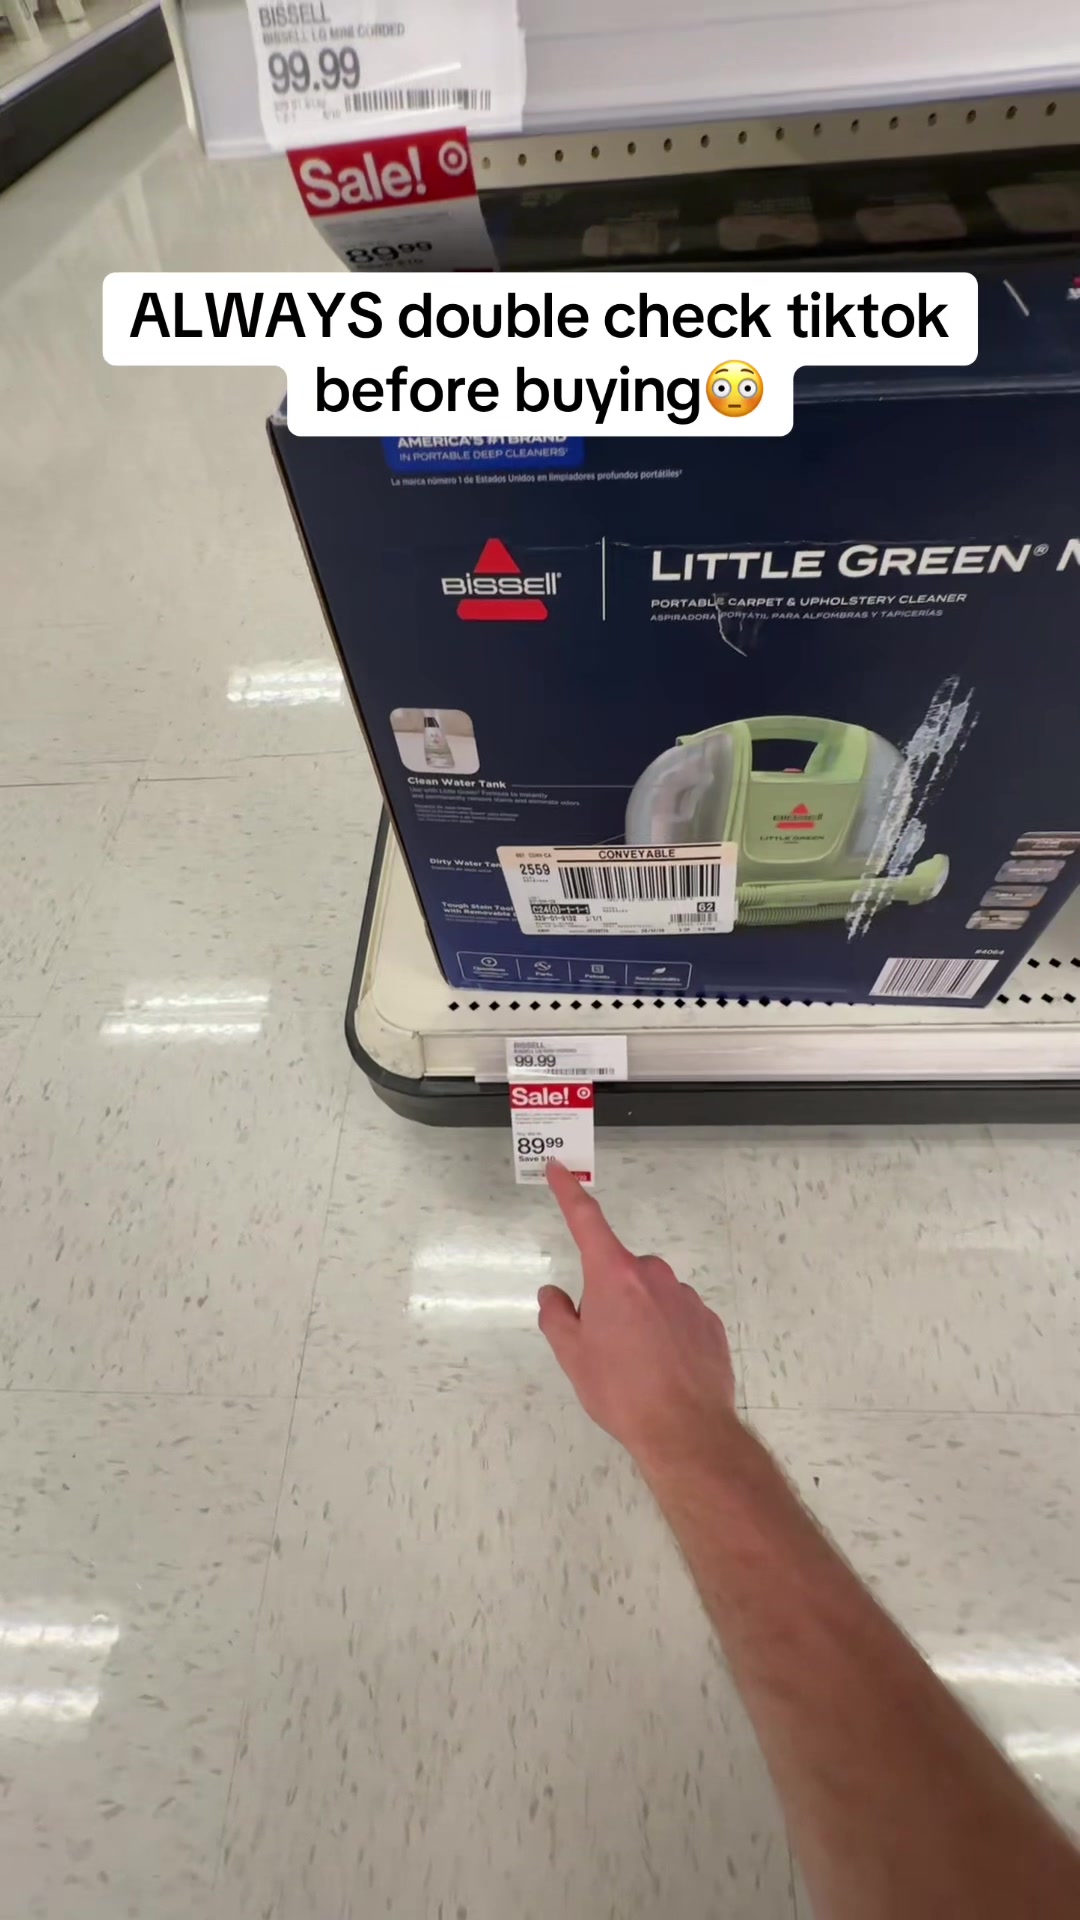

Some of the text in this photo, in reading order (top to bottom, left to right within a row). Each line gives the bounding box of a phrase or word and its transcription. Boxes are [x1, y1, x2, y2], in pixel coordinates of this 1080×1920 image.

[259, 1, 331, 28] BISSELL
[268, 47, 361, 95] 99.99
[300, 146, 427, 208] Sale!
[400, 453, 411, 462] IN
[413, 450, 471, 462] PORTABLE
[473, 449, 504, 460] DEEP
[390, 477, 400, 487] La
[402, 477, 426, 487] marca
[427, 475, 457, 486] número
[458, 476, 463, 485] 1
[464, 475, 474, 485] de
[475, 473, 507, 485] Estados
[508, 472, 536, 483] Unidos
[537, 474, 548, 482] en
[549, 470, 596, 483] limpiadores
[597, 469, 639, 482] profundos
[651, 550, 825, 581] LITTLE
[651, 592, 968, 609] PORTABLE CARPET & UPHOLSTERY CLEANER
[650, 612, 717, 622] ASPIRADORA
[771, 612, 800, 620] PARA
[802, 610, 869, 620] ALFOMBRAS
[871, 610, 878, 618] Y
[880, 608, 944, 618] TAPICERÍAS
[407, 776, 507, 789] Clean Water Tank
[598, 849, 676, 859] CONVEYABLE
[429, 858, 452, 867] Dirty
[454, 859, 482, 868] Water
[484, 861, 502, 869] Tan
[519, 863, 551, 877] 2559
[441, 901, 469, 910] Tough
[470, 903, 493, 911] Stain
[443, 907, 511, 918] with Removable
[698, 902, 714, 912] 62
[514, 1054, 556, 1068] 99.99
[511, 1087, 569, 1106] Sale!
